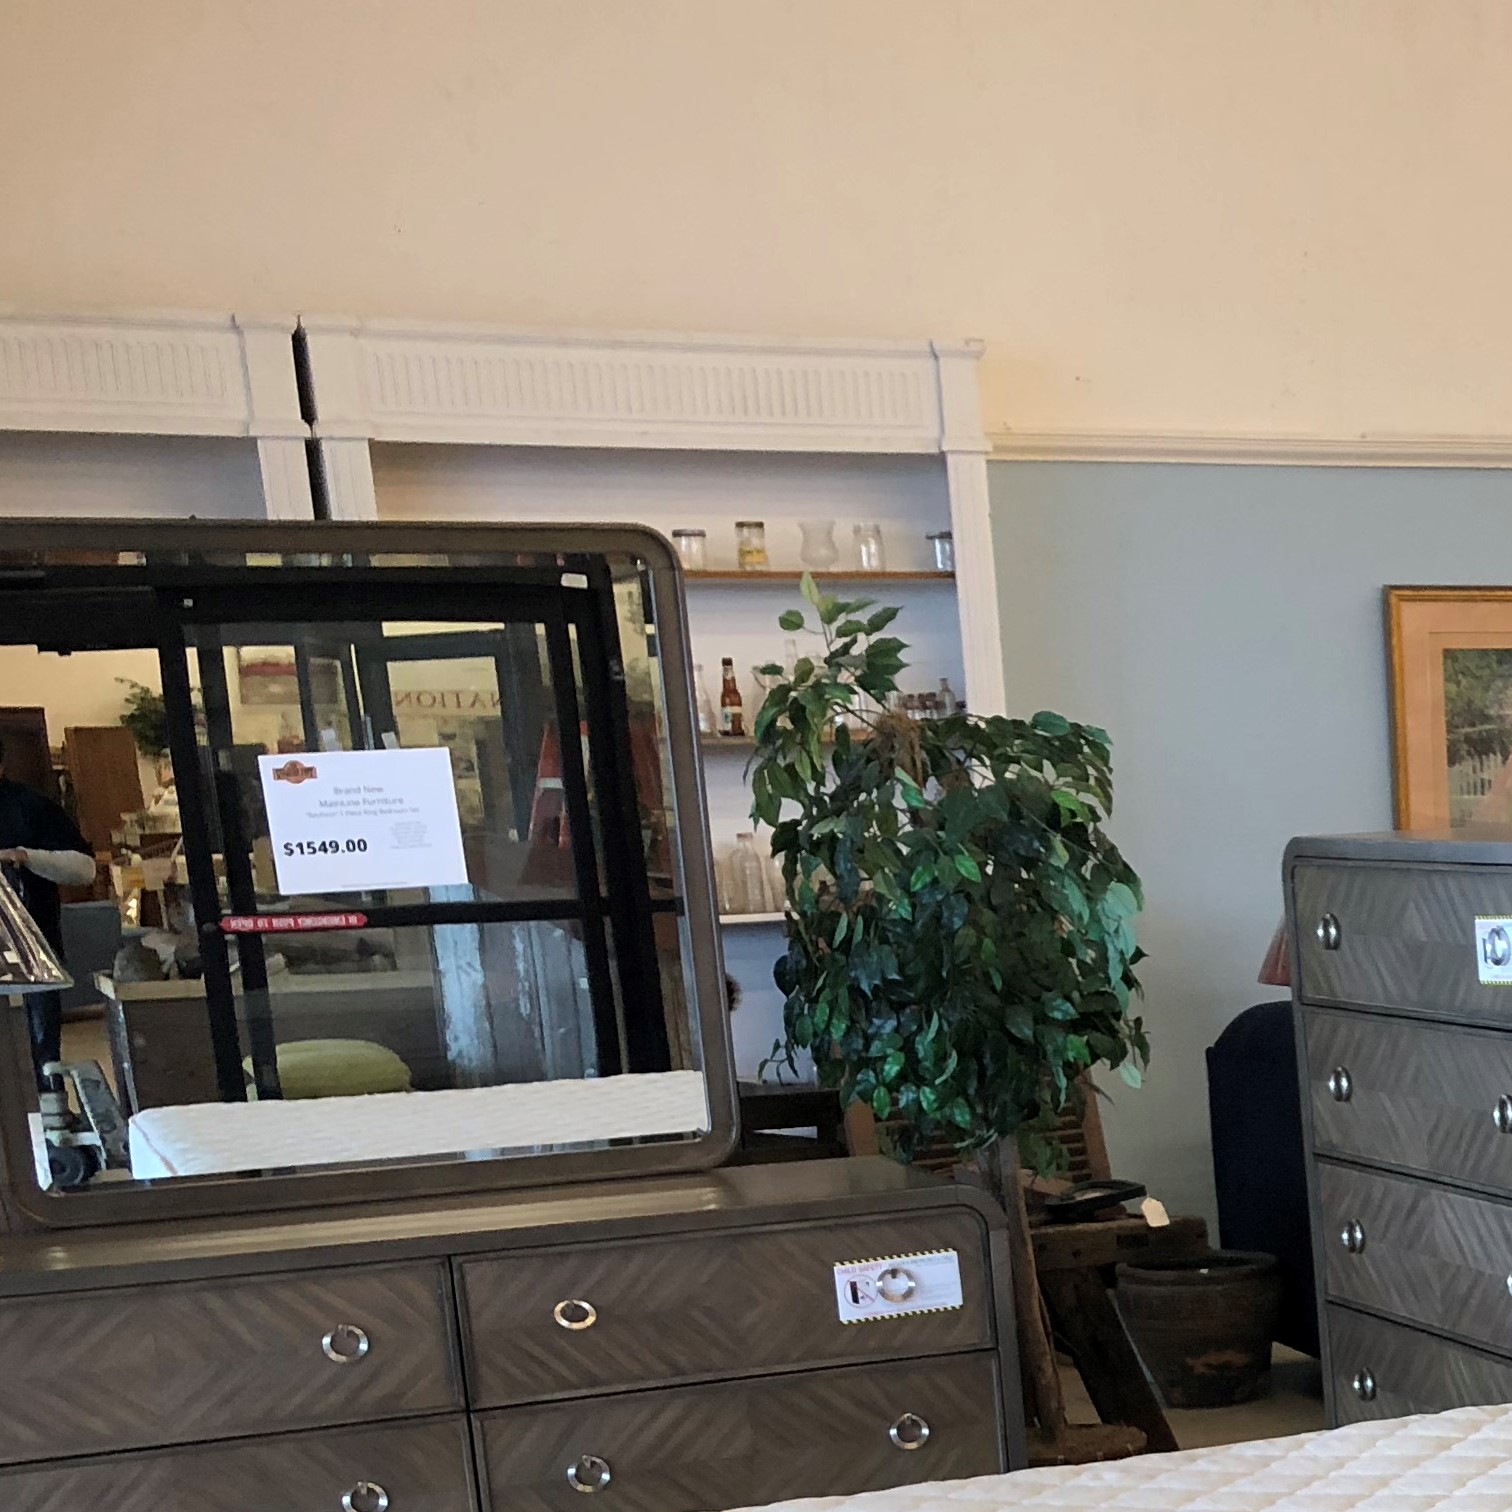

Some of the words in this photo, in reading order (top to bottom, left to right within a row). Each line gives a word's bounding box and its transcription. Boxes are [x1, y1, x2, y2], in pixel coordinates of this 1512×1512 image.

[333, 785, 361, 795] Brand
[363, 784, 384, 794] New
[362, 796, 404, 807] Furniture
[283, 838, 368, 857] $1549.00
